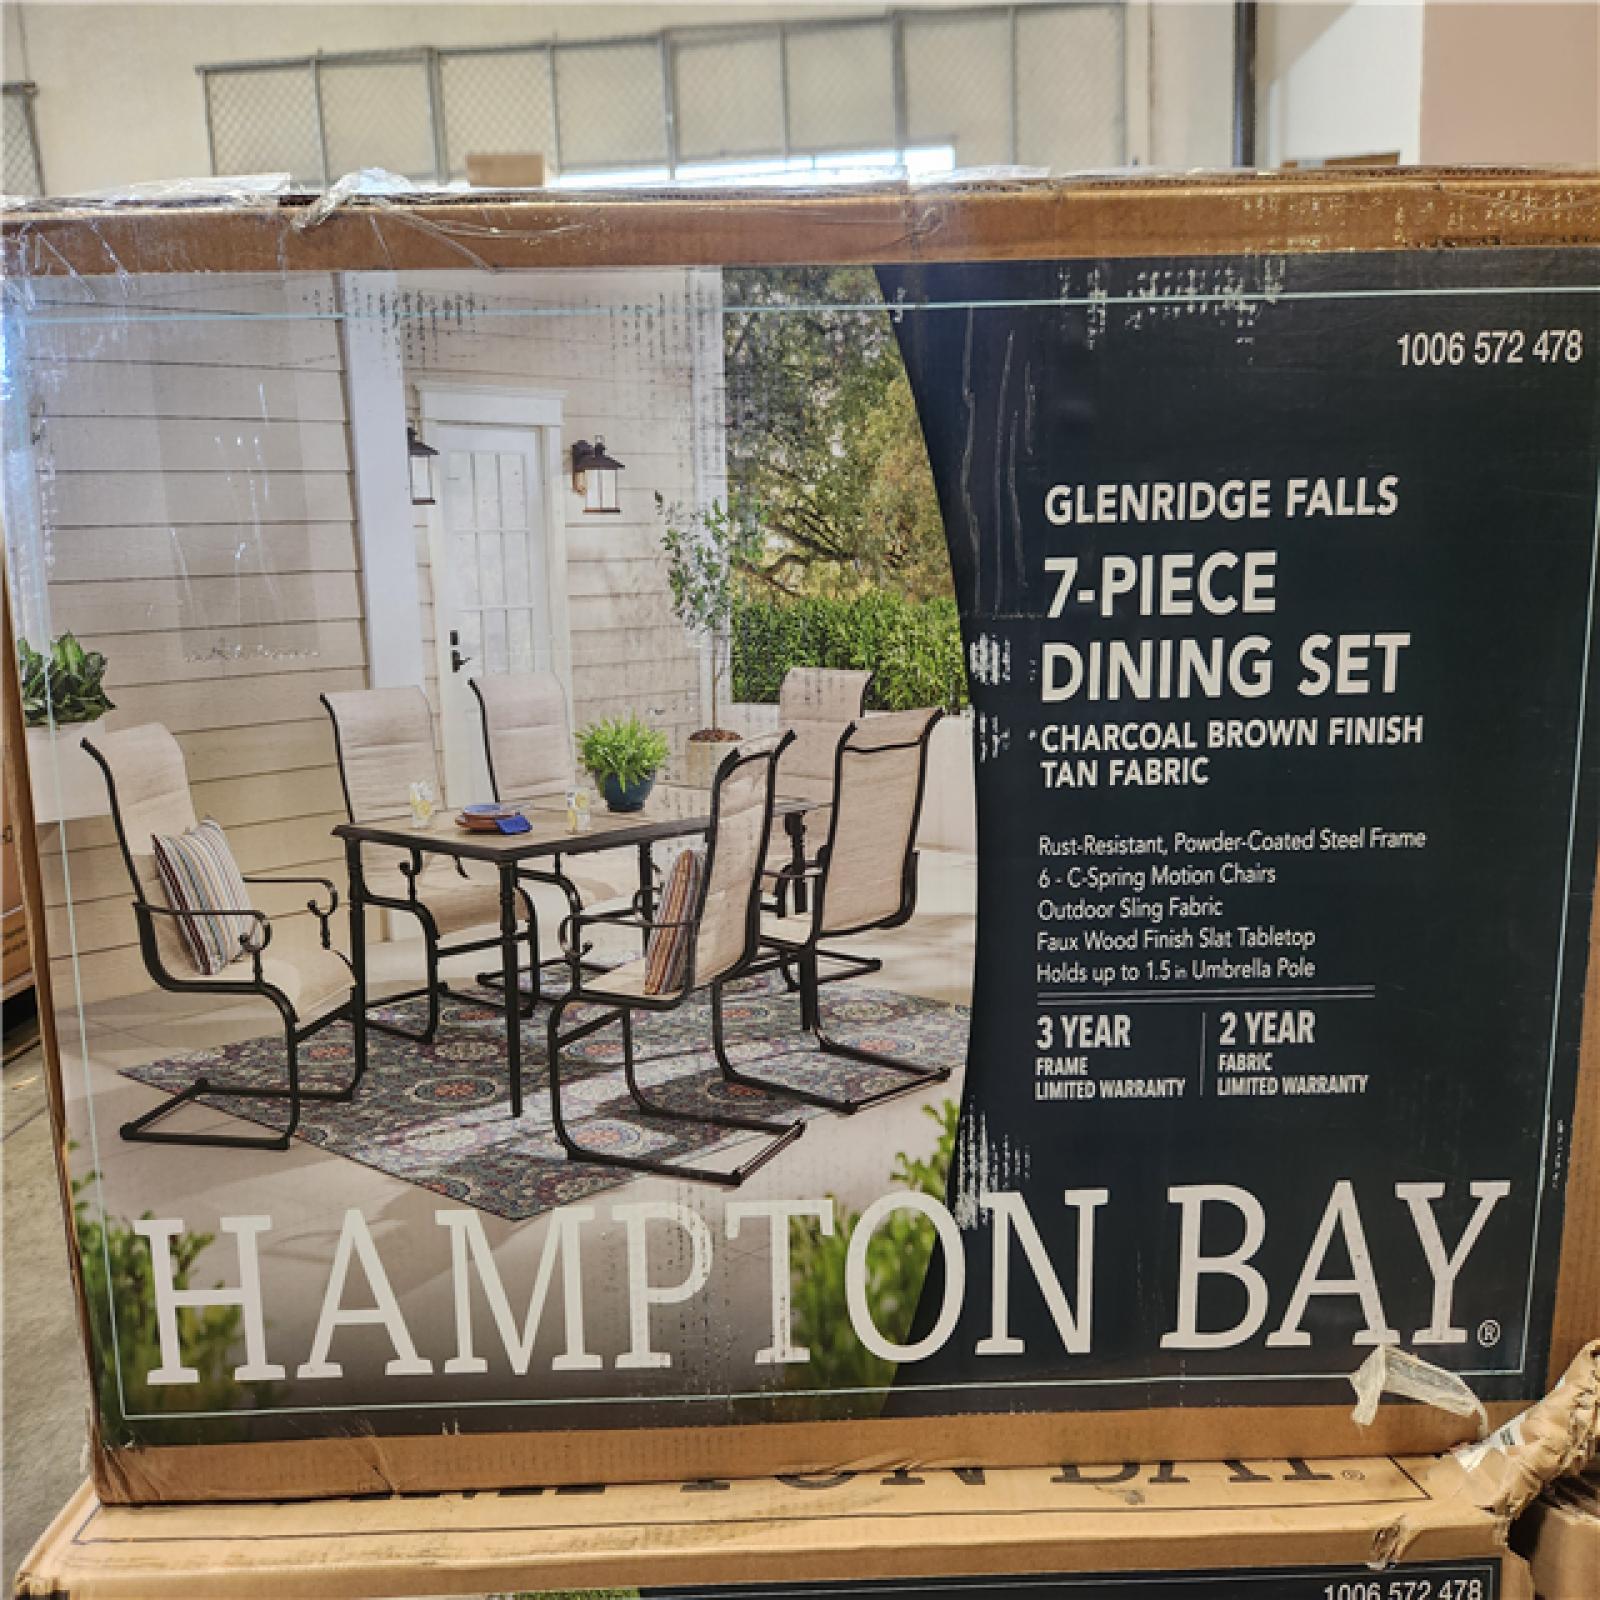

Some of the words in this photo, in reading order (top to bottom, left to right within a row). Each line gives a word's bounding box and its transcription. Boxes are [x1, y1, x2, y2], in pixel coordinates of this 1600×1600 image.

[1397, 331, 1465, 365] 1006
[1474, 330, 1525, 365] 572
[1533, 330, 1582, 363] 478
[1045, 480, 1270, 525] GLENRIDGE
[1287, 475, 1398, 517] FALLS
[1045, 551, 1277, 618] 7-PIECE
[1042, 635, 1272, 702] DINING
[1297, 633, 1410, 695] SET
[1042, 722, 1197, 753] CHARCOAL
[1208, 718, 1318, 748] BROWN
[1330, 715, 1423, 745] FINISH
[1040, 760, 1097, 788] TAN
[1110, 757, 1208, 785] FABRIC
[1040, 835, 1168, 855] Rust-Resistant,
[1175, 829, 1315, 853] Powder-Coated
[1320, 828, 1365, 850] Steel
[1370, 827, 1425, 848] Frame
[1038, 868, 1050, 888] 6
[1067, 867, 1145, 892] C-Spring
[1152, 865, 1215, 885] Motion
[1220, 863, 1275, 883] Chairs
[1038, 900, 1115, 920] Outdoor
[1120, 897, 1163, 923] Sling
[1170, 895, 1223, 917] Fabric
[1038, 932, 1078, 950] Faux
[1085, 929, 1138, 950] Wood
[1144, 928, 1193, 948] Finish
[1200, 927, 1230, 948] Slat
[1237, 926, 1315, 950] Tabletop
[1037, 962, 1087, 983] Holds
[1093, 967, 1115, 987] up
[1120, 965, 1140, 980] to
[1147, 960, 1170, 980] 1.5
[1192, 958, 1270, 980] Umbrella
[1277, 957, 1315, 977] Pole
[1037, 1015, 1053, 1050] 3
[1060, 1015, 1130, 1048] YEAR
[1220, 1011, 1237, 1045] 2
[1245, 1010, 1315, 1045] YEAR
[1035, 1057, 1088, 1075] FRAME
[1218, 1052, 1272, 1072] FABRIC
[1035, 1080, 1095, 1100] LIMITED
[1100, 1078, 1185, 1098] WARRANTY
[1218, 1077, 1278, 1095] LIMITED
[1282, 1075, 1368, 1095] WARRANTY
[133, 1188, 1109, 1386] HAMPTON
[1160, 1179, 1511, 1349] BAY
